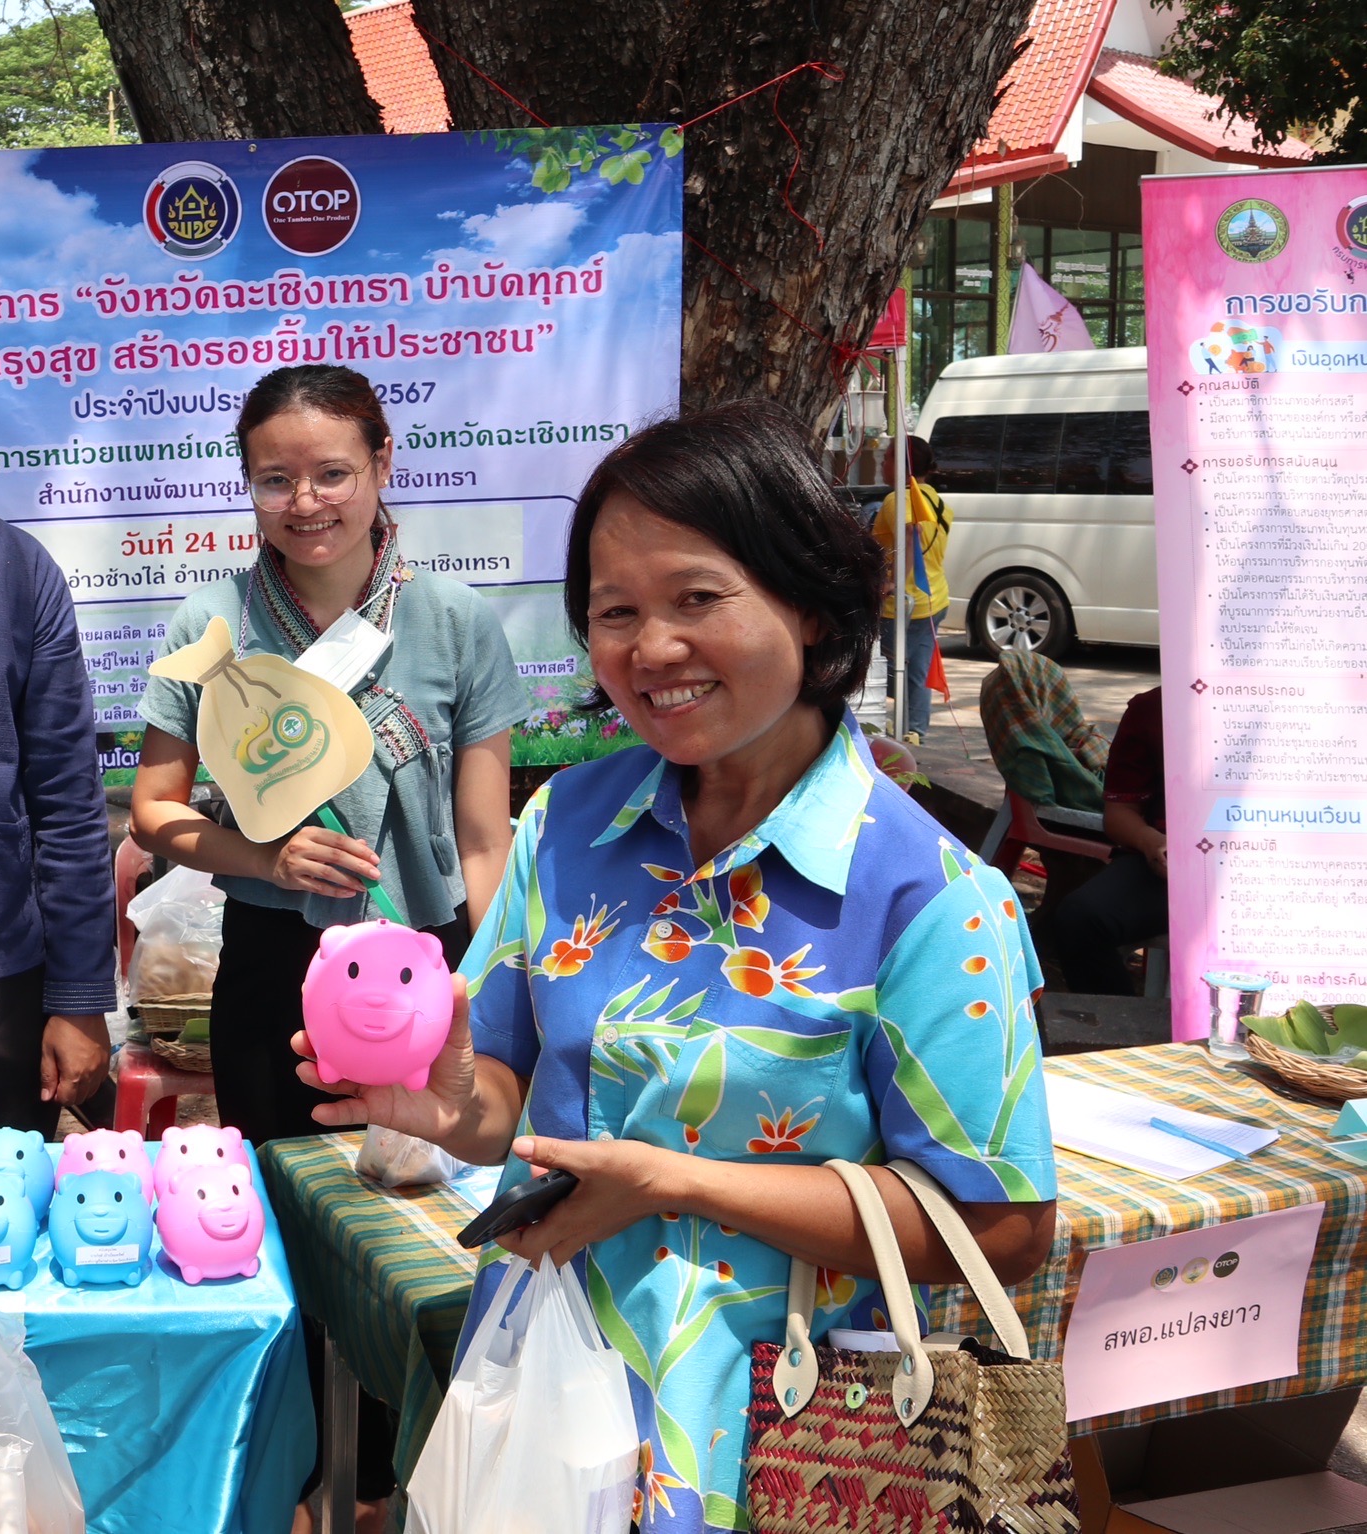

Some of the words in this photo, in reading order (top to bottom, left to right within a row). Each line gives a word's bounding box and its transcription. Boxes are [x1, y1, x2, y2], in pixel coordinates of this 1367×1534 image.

[272, 189, 351, 212] OTOP
[326, 214, 350, 222] Product
[76, 272, 409, 315] “จังหวัดฉะเชิงเทรา
[425, 256, 605, 305] บำบัดทุกข์
[114, 318, 554, 369] สร้างรอยยิ้มให้ประชาชน”
[74, 386, 247, 420] ประจำปีงบประ
[374, 381, 437, 405] 2567
[121, 523, 174, 557] วันที่
[185, 531, 218, 553] 24
[68, 563, 166, 588] อ่าวช้างไล่
[515, 658, 576, 675] บาทสตรี
[1212, 684, 1305, 697] เอกสารประกอบ
[1225, 804, 1361, 828] เงินทุนหมุนเวียน
[1104, 1302, 1263, 1352] สพอ.แปลงยาว
